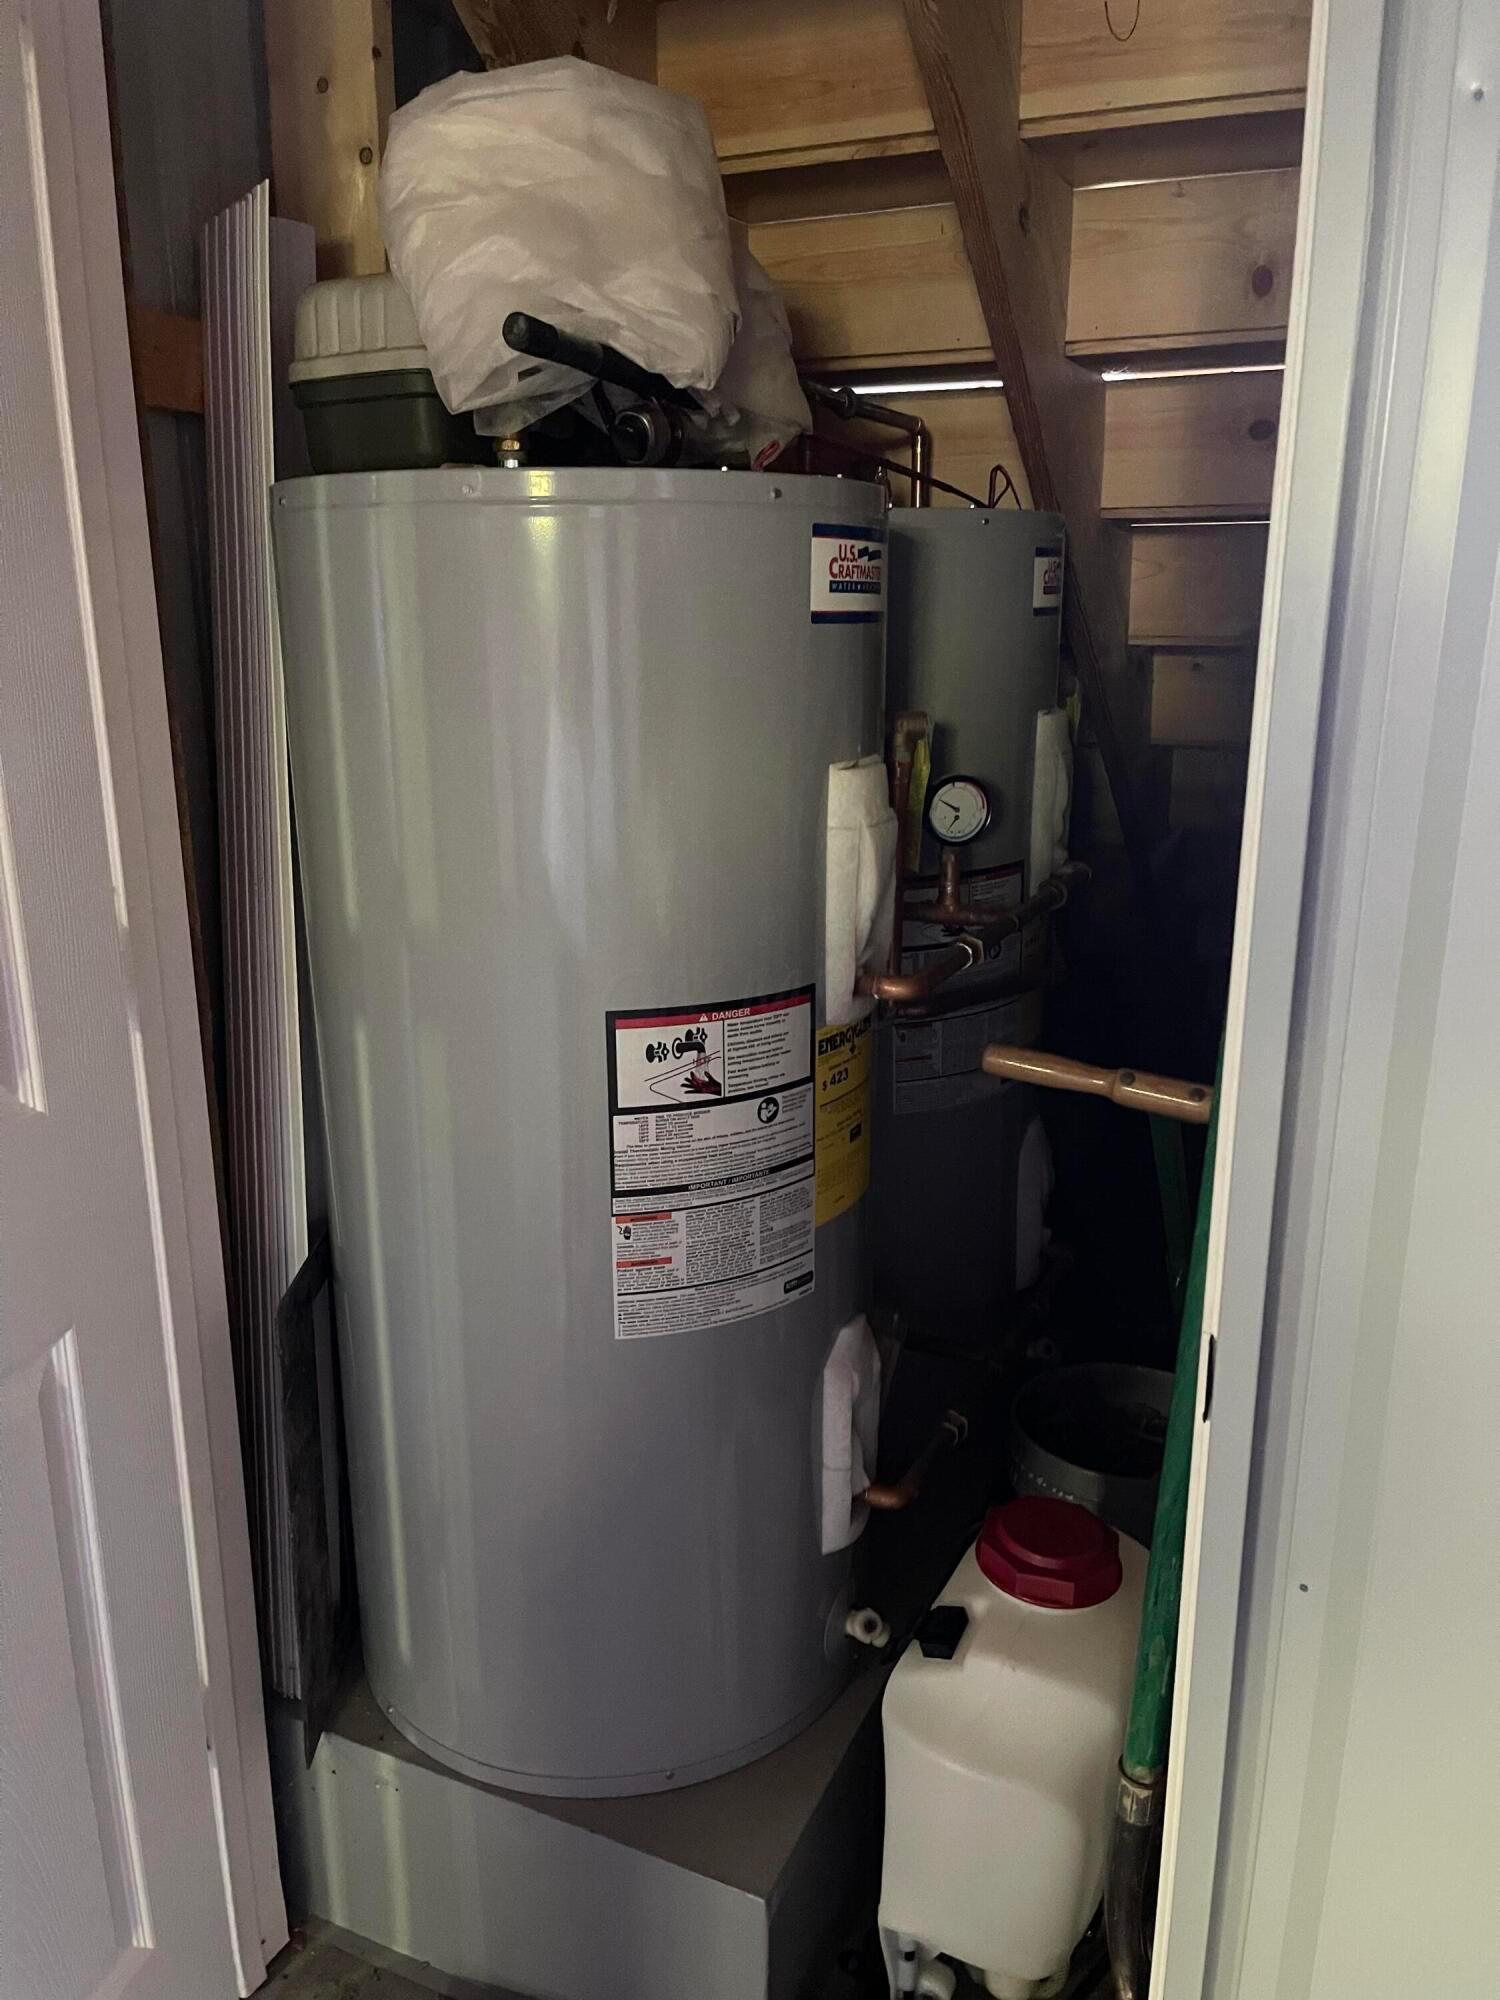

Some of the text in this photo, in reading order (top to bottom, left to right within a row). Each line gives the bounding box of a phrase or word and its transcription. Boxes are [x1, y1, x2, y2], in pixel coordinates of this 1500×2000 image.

[839, 543, 858, 563] U.S.
[712, 1007, 751, 1022] DANGER
[688, 1179, 727, 1190] IMPORTANT
